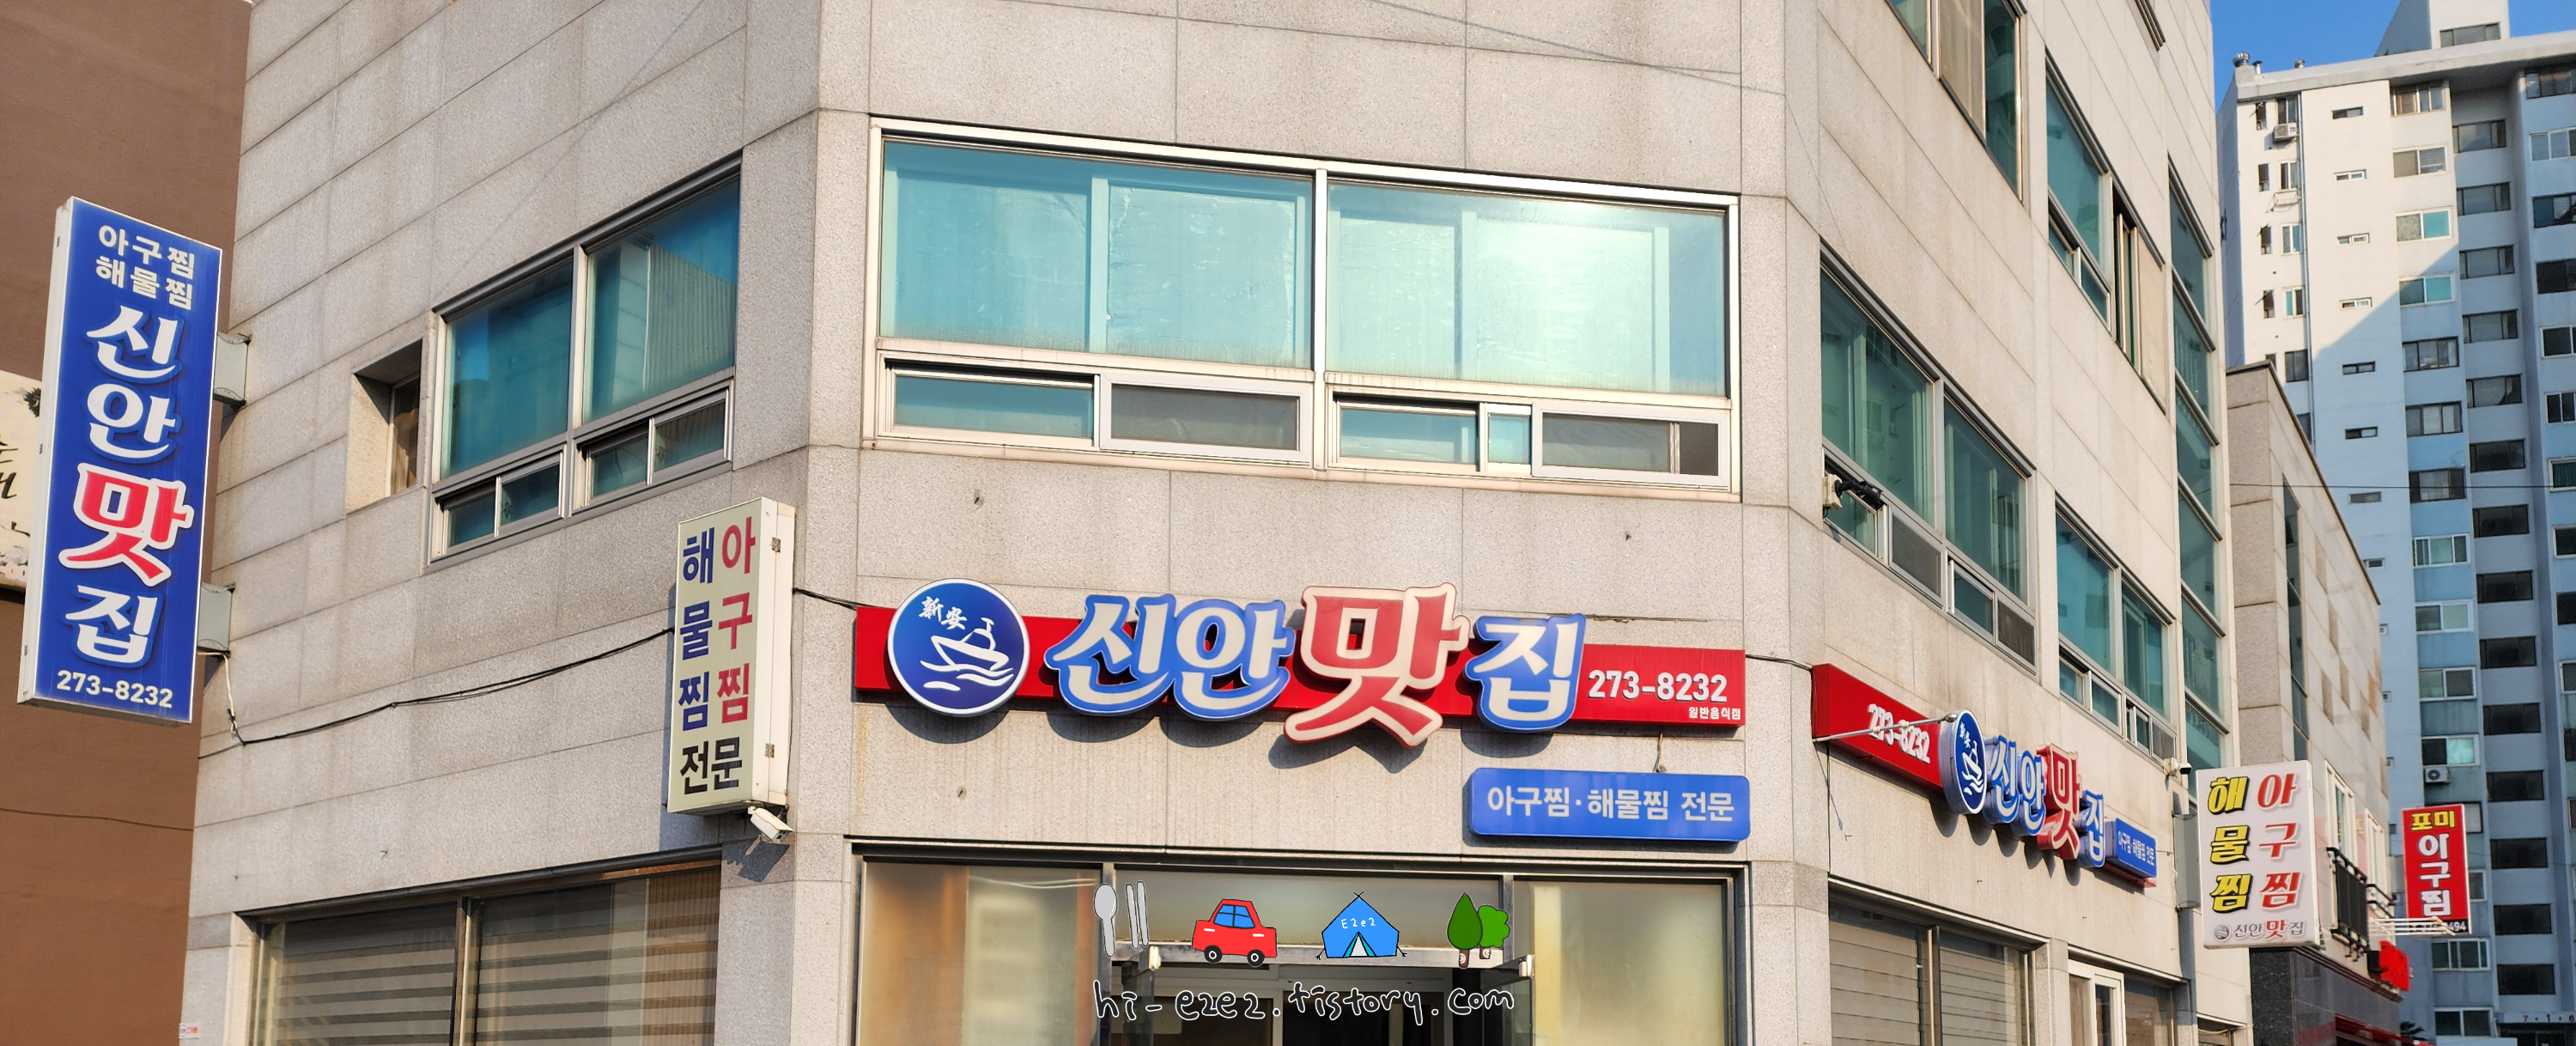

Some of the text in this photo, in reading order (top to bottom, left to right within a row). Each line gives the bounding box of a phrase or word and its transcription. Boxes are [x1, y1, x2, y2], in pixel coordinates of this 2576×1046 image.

[98, 223, 195, 281] 아구찜
[94, 255, 193, 310] 해물찜
[60, 304, 194, 666] 신안맛집
[678, 526, 715, 732] 해물찜
[717, 516, 756, 724] 아구찜
[56, 669, 173, 709] 273-8232
[1046, 583, 1586, 746] 신안맛집
[1588, 669, 1728, 703] 273-8232
[1688, 706, 1741, 721] 일반음식점
[1868, 703, 1931, 764] 273-8232
[679, 736, 744, 795] 전문
[1680, 790, 1735, 823] 전문
[1991, 735, 2105, 867] 신안맛집
[2410, 810, 2456, 831] 포미
[2208, 775, 2253, 914] 해물찜
[2257, 773, 2301, 909] 아구찜
[2233, 919, 2305, 940] 신안맛집
